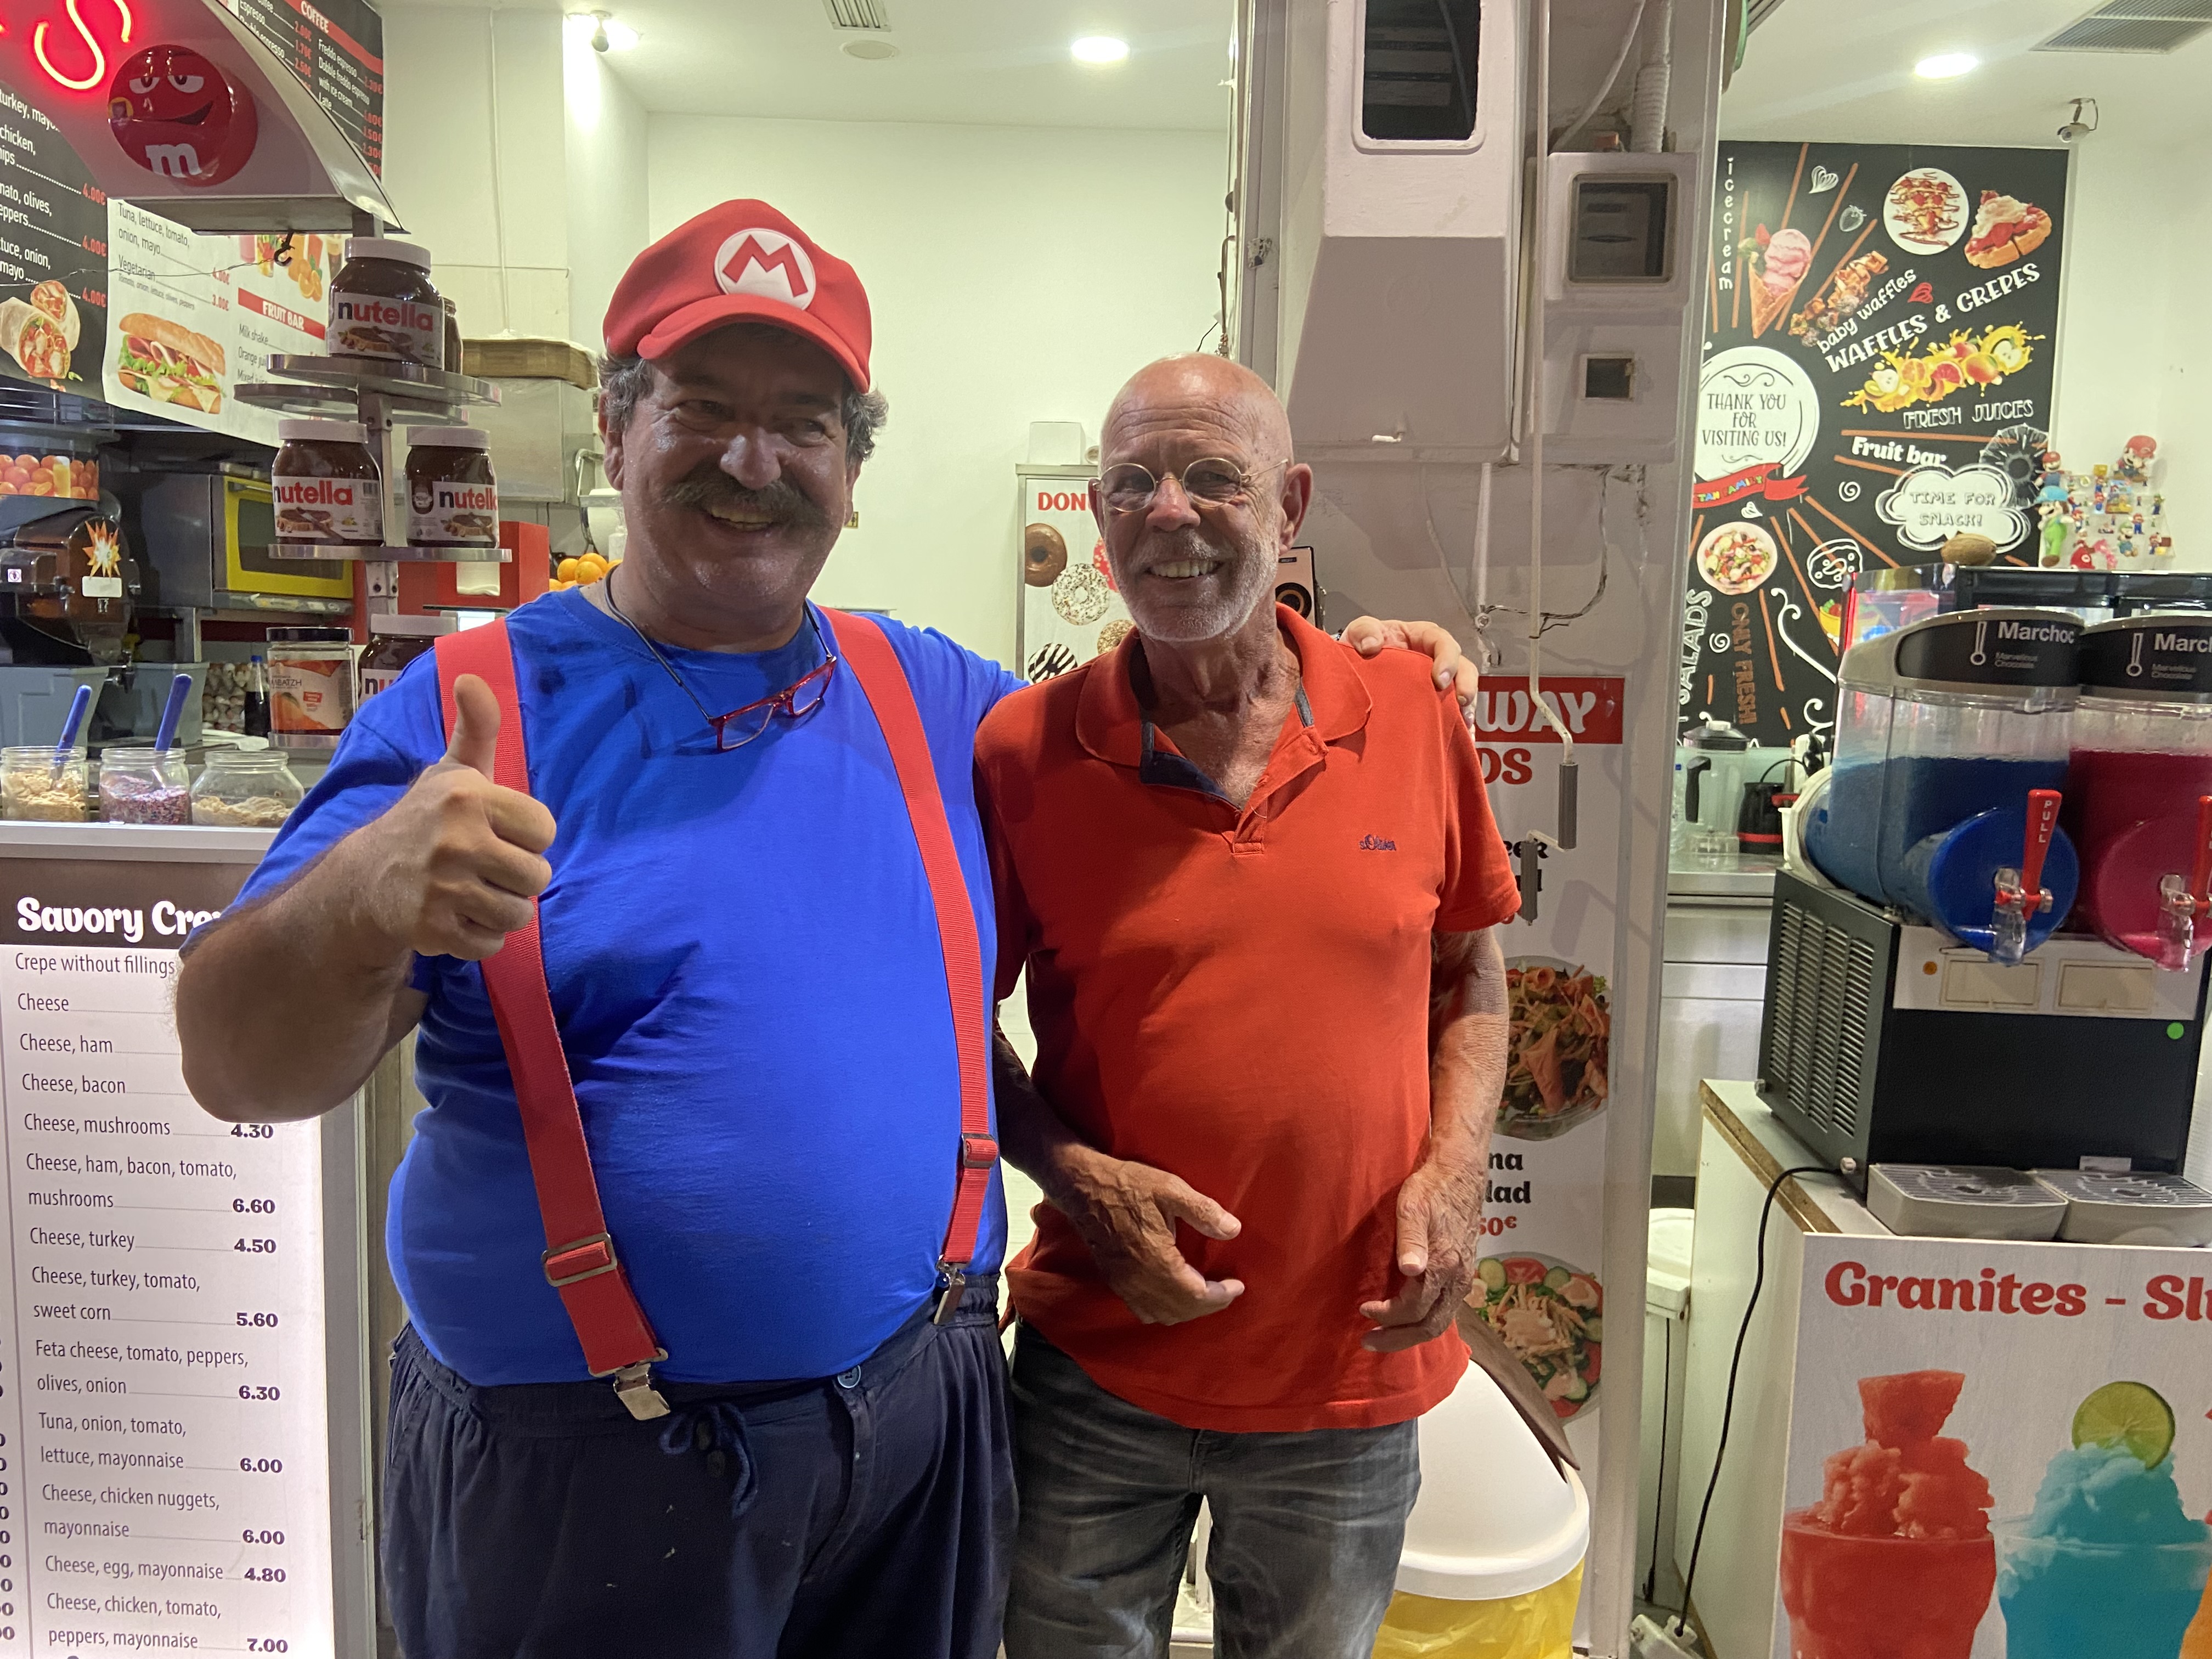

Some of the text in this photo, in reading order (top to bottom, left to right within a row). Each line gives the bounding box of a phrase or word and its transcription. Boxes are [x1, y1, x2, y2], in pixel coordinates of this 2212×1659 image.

[301, 1, 329, 33] COFFEE
[319, 39, 336, 61] Freddo
[145, 143, 202, 178] m
[23, 191, 53, 217] olives,
[82, 183, 106, 206] 4.00€
[118, 202, 190, 249] Tuna, lettuce, tomato,
[82, 235, 107, 257] 4.00€
[119, 228, 160, 255] onion, mayo
[0, 261, 24, 281] mayo
[24, 248, 51, 270] onion,
[119, 255, 155, 281] Vegetarian
[723, 234, 809, 298] M
[82, 287, 106, 307] 4.00€
[263, 300, 304, 330] FRUIT BAR
[338, 301, 433, 332] nutella
[1816, 268, 1917, 354] baby waffles
[1824, 262, 2041, 373] WAFFLES & CREPES
[251, 329, 268, 345] shake
[238, 346, 258, 366] Orange
[1707, 393, 1787, 410] THANK YOU
[1903, 399, 2034, 430] FRESH JUICES
[1732, 411, 1756, 429] FOR
[1702, 430, 1787, 448] VISITING US!
[1852, 436, 1947, 466] Fruit bar
[1037, 492, 1092, 511] DON
[1910, 492, 1995, 506] TIME FOR
[1919, 513, 1983, 527] SNACK!
[1731, 601, 1752, 656] ONLY
[2038, 799, 2053, 843] PULL
[17, 896, 222, 943] Savory Cre
[15, 952, 175, 978] Crepe without fillings
[18, 993, 70, 1012] Cheese
[20, 1033, 113, 1055] Cheese, ham
[22, 1073, 126, 1095] Cheese, bacon
[24, 1113, 274, 1139] Cheese, mushrooms 4.30
[26, 1153, 238, 1181] Cheese, ham, bacon, tomato,
[28, 1189, 276, 1214] mushrooms 6.60
[30, 1227, 277, 1254] Cheese, turkey 4.50
[32, 1266, 201, 1293] Cheese, turkey, tomato,
[1824, 1261, 2087, 1317] Granites
[33, 1303, 279, 1328] sweet corn 5.60
[36, 1339, 249, 1368] Feta cheese, tomato, peppers,
[37, 1374, 281, 1401] olives, onion 6.30
[39, 1412, 187, 1437] Tuna, onion, tomato,
[41, 1446, 283, 1474] lettuce, mayonnaise 6.00
[42, 1484, 220, 1511] Cheese, chicken nuggets,
[44, 1520, 285, 1545] mayonnaise 6.00
[46, 1555, 287, 1583] Cheese, egg, mayonnaise 4.80
[47, 1593, 221, 1619] Cheese, chicken, tomato,
[49, 1628, 289, 1654] peppers, mayonnaise 7.00
